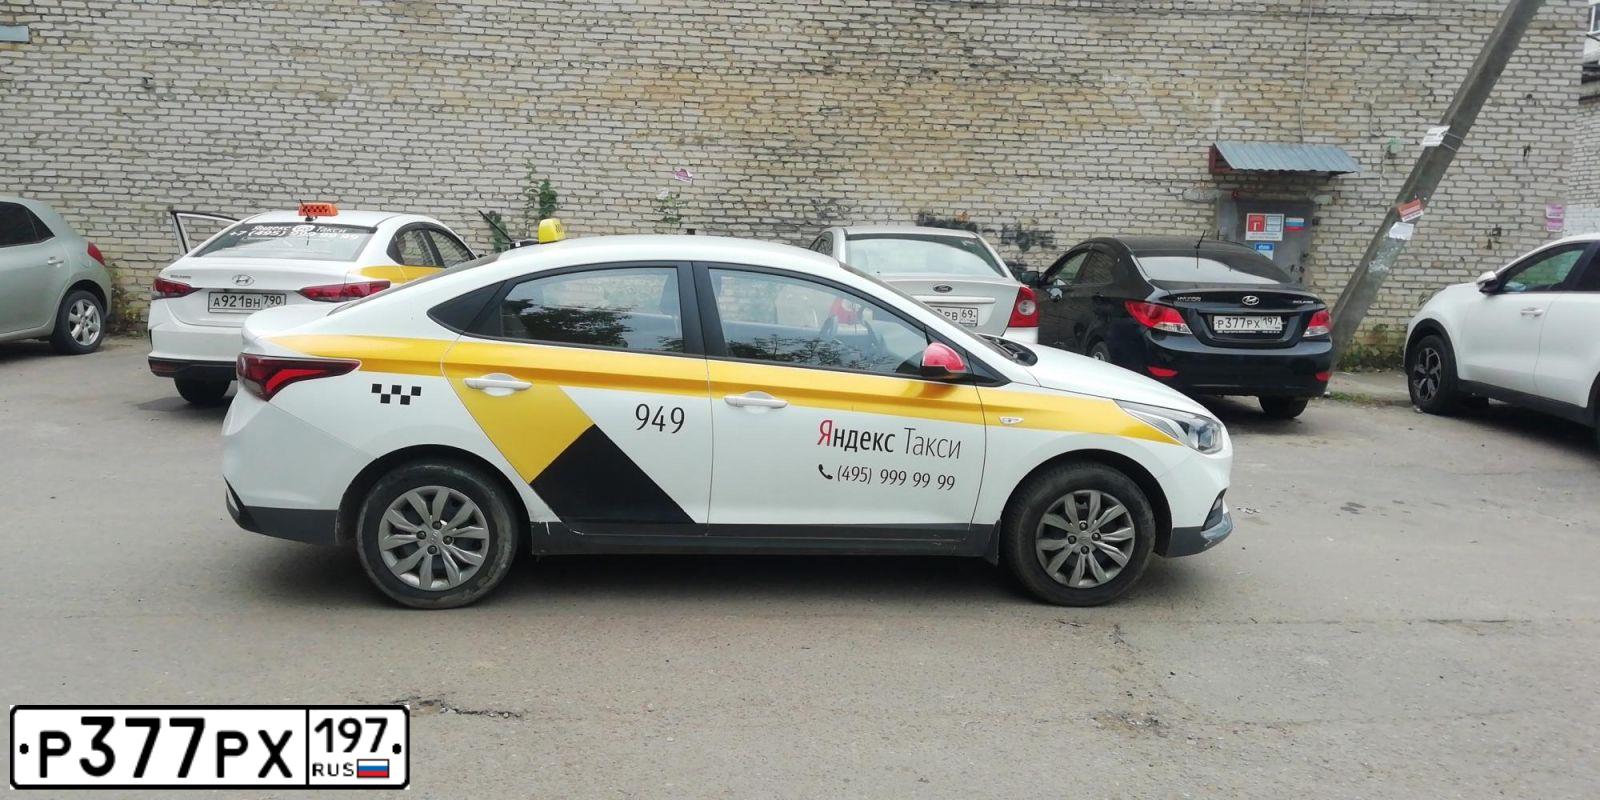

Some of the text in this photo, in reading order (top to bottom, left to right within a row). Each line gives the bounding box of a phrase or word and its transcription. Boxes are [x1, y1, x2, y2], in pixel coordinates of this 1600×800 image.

[263, 295, 282, 305] 790
[1262, 316, 1278, 326] 197
[634, 403, 686, 435] 949
[817, 419, 962, 460] Яндекс Такси
[837, 465, 956, 491] (495) 999 99 99
